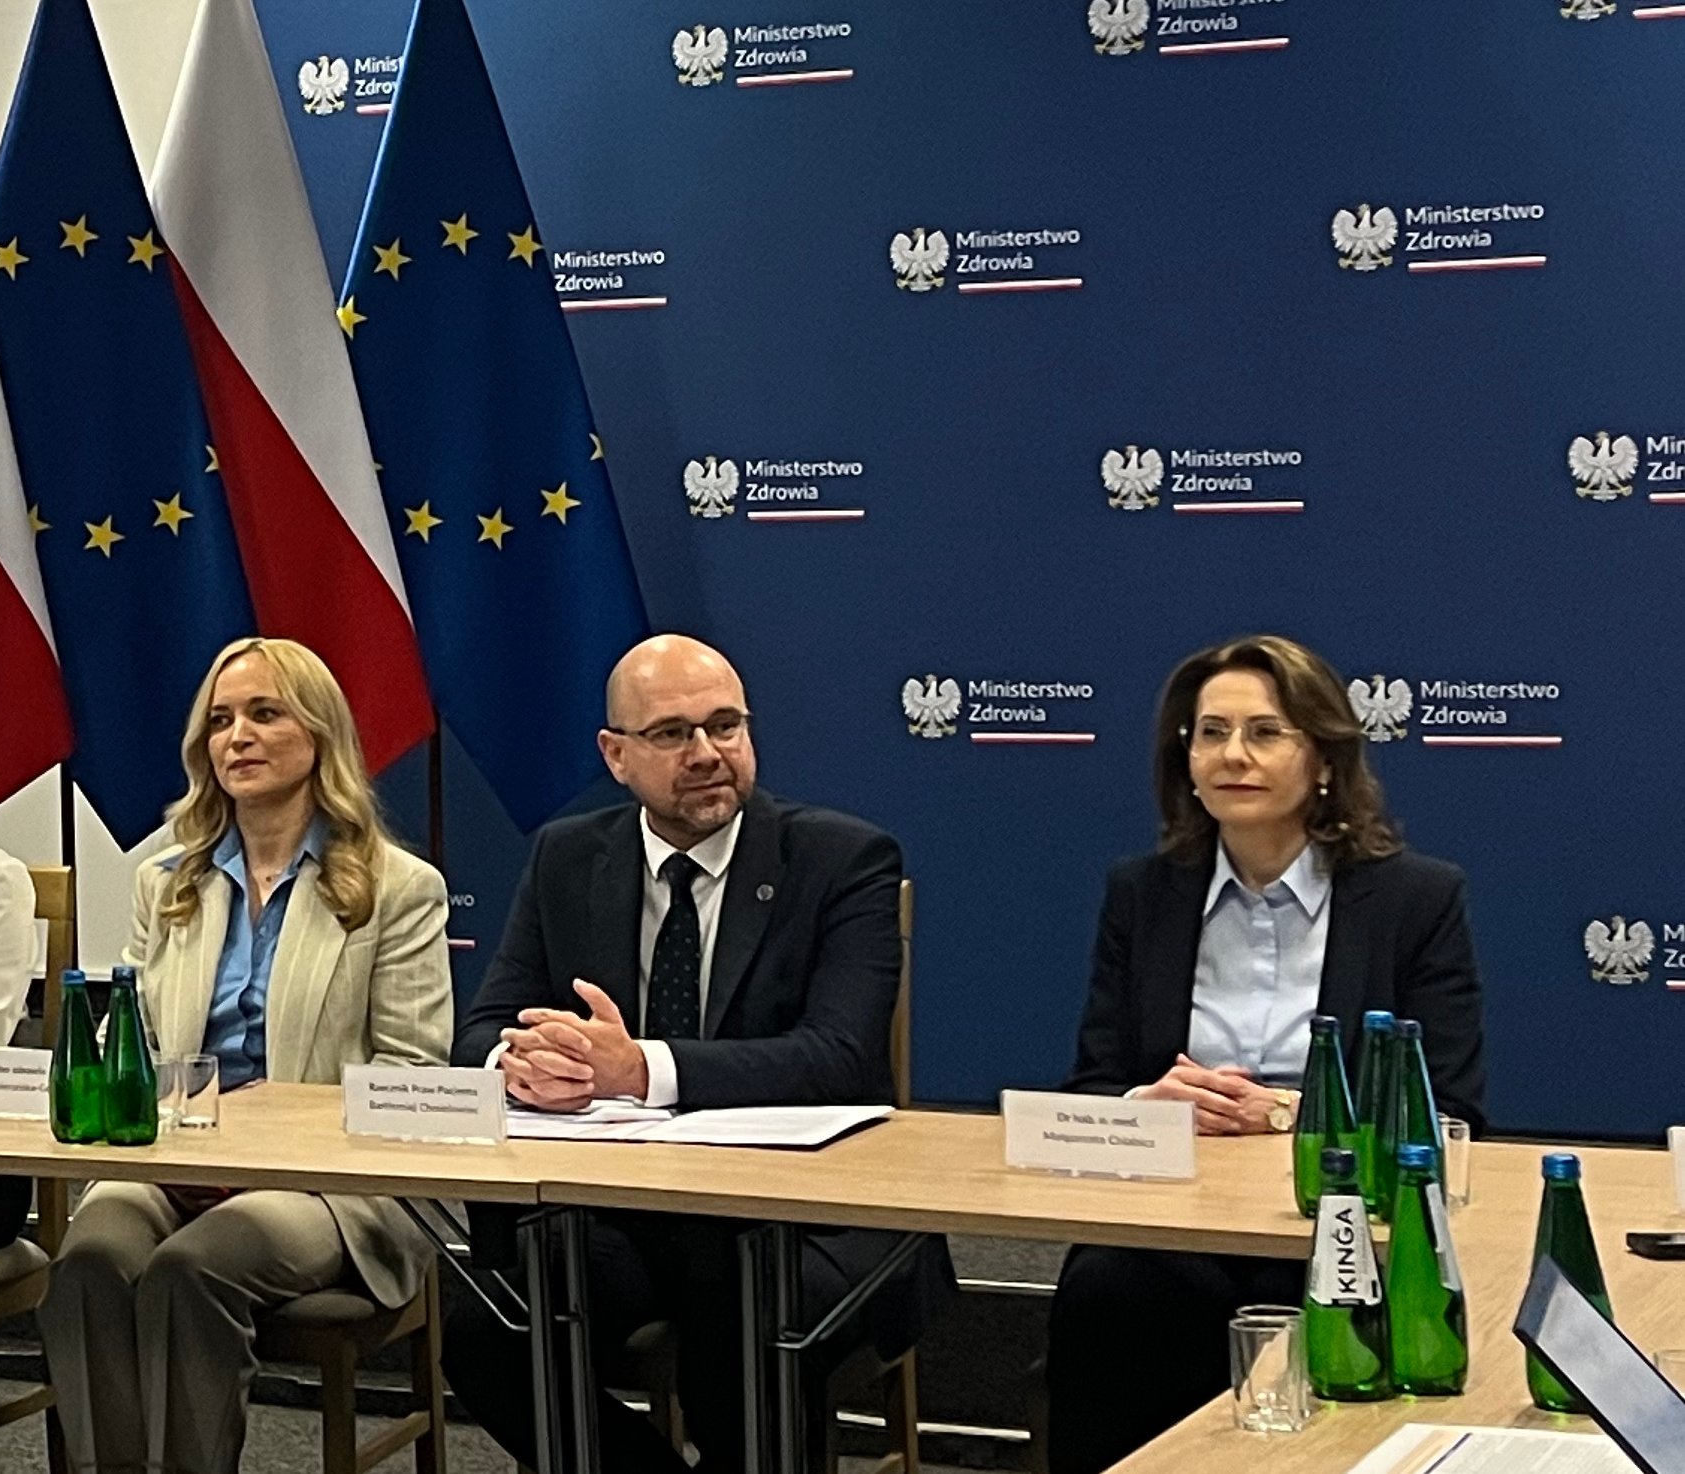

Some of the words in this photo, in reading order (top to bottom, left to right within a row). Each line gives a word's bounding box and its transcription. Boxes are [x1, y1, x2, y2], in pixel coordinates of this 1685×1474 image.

[734, 23, 852, 45] Ministerstwo
[1156, 12, 1238, 35] Zdrowia
[734, 45, 807, 68] Zdrowia
[1405, 203, 1545, 226] Ministerstwo
[956, 229, 1081, 250] Ministerstwo
[1404, 229, 1492, 251] Zdrowia
[554, 250, 665, 269] Ministerstwo
[956, 251, 1034, 273] Zdrowia
[553, 271, 623, 292] Zdrowia
[745, 459, 863, 477] Ministerstwo
[1170, 449, 1302, 468] Ministerstwo
[745, 482, 819, 501] Zdrowia
[1171, 472, 1253, 493] Zdrowia
[968, 680, 1094, 699] Ministerstwo
[1420, 680, 1560, 699] Ministerstwo
[968, 703, 1047, 722] Zdrowia
[1420, 704, 1507, 725] Zdrowia
[1334, 1208, 1357, 1293] KINGA
